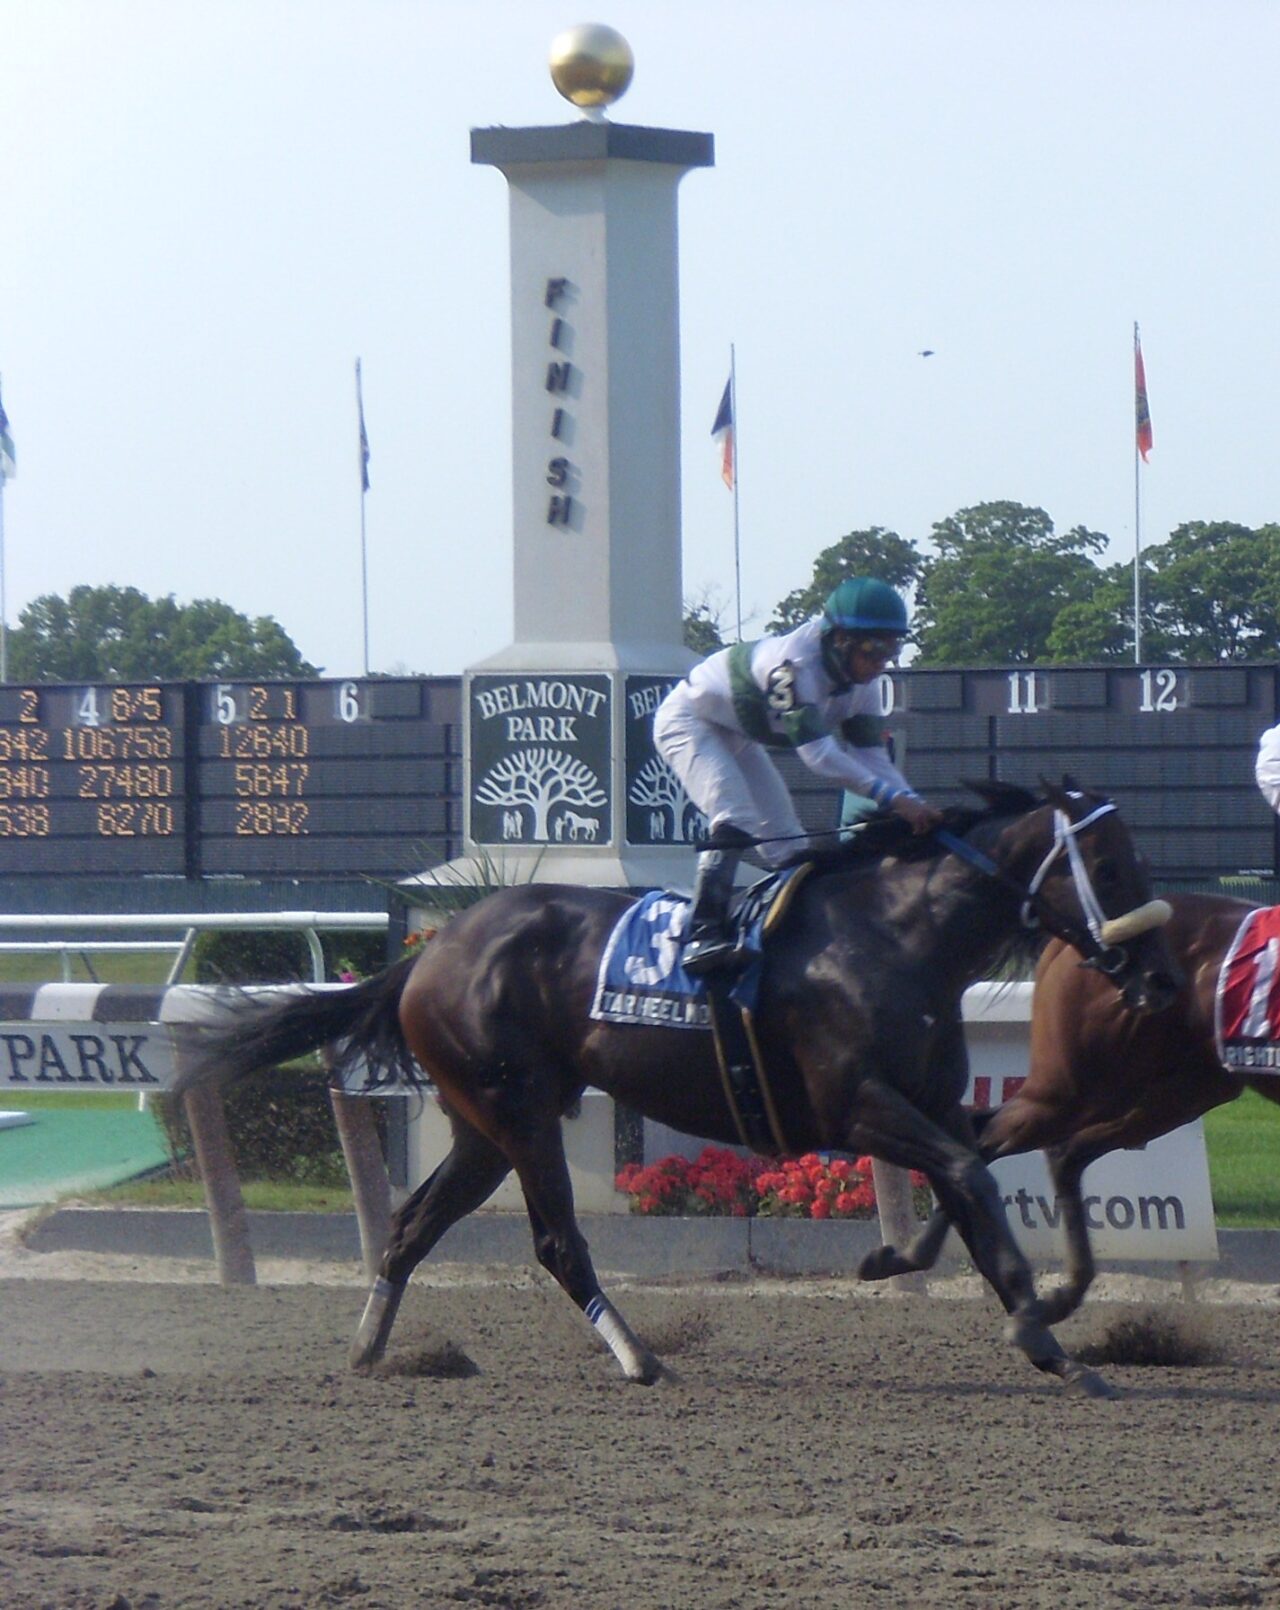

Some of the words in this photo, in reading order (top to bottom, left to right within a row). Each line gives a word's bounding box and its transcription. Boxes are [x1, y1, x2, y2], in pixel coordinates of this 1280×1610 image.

[545, 277, 573, 525] FINISH
[20, 690, 38, 722] 2
[79, 687, 99, 726] 4
[217, 684, 236, 724] 5
[339, 682, 358, 723] 6
[476, 682, 607, 720] BELMONT
[768, 666, 794, 710] 3
[879, 673, 894, 717] 0
[1008, 671, 1038, 714] 11
[1140, 669, 1177, 712] 12
[220, 725, 308, 758] 12640
[507, 716, 578, 742] PARK
[78, 765, 171, 798] 27480
[235, 764, 309, 796] 5647
[624, 900, 690, 985] 3
[602, 991, 683, 1022] TARHEEL
[1242, 937, 1280, 1037] 1
[0, 1034, 159, 1083] PARK
